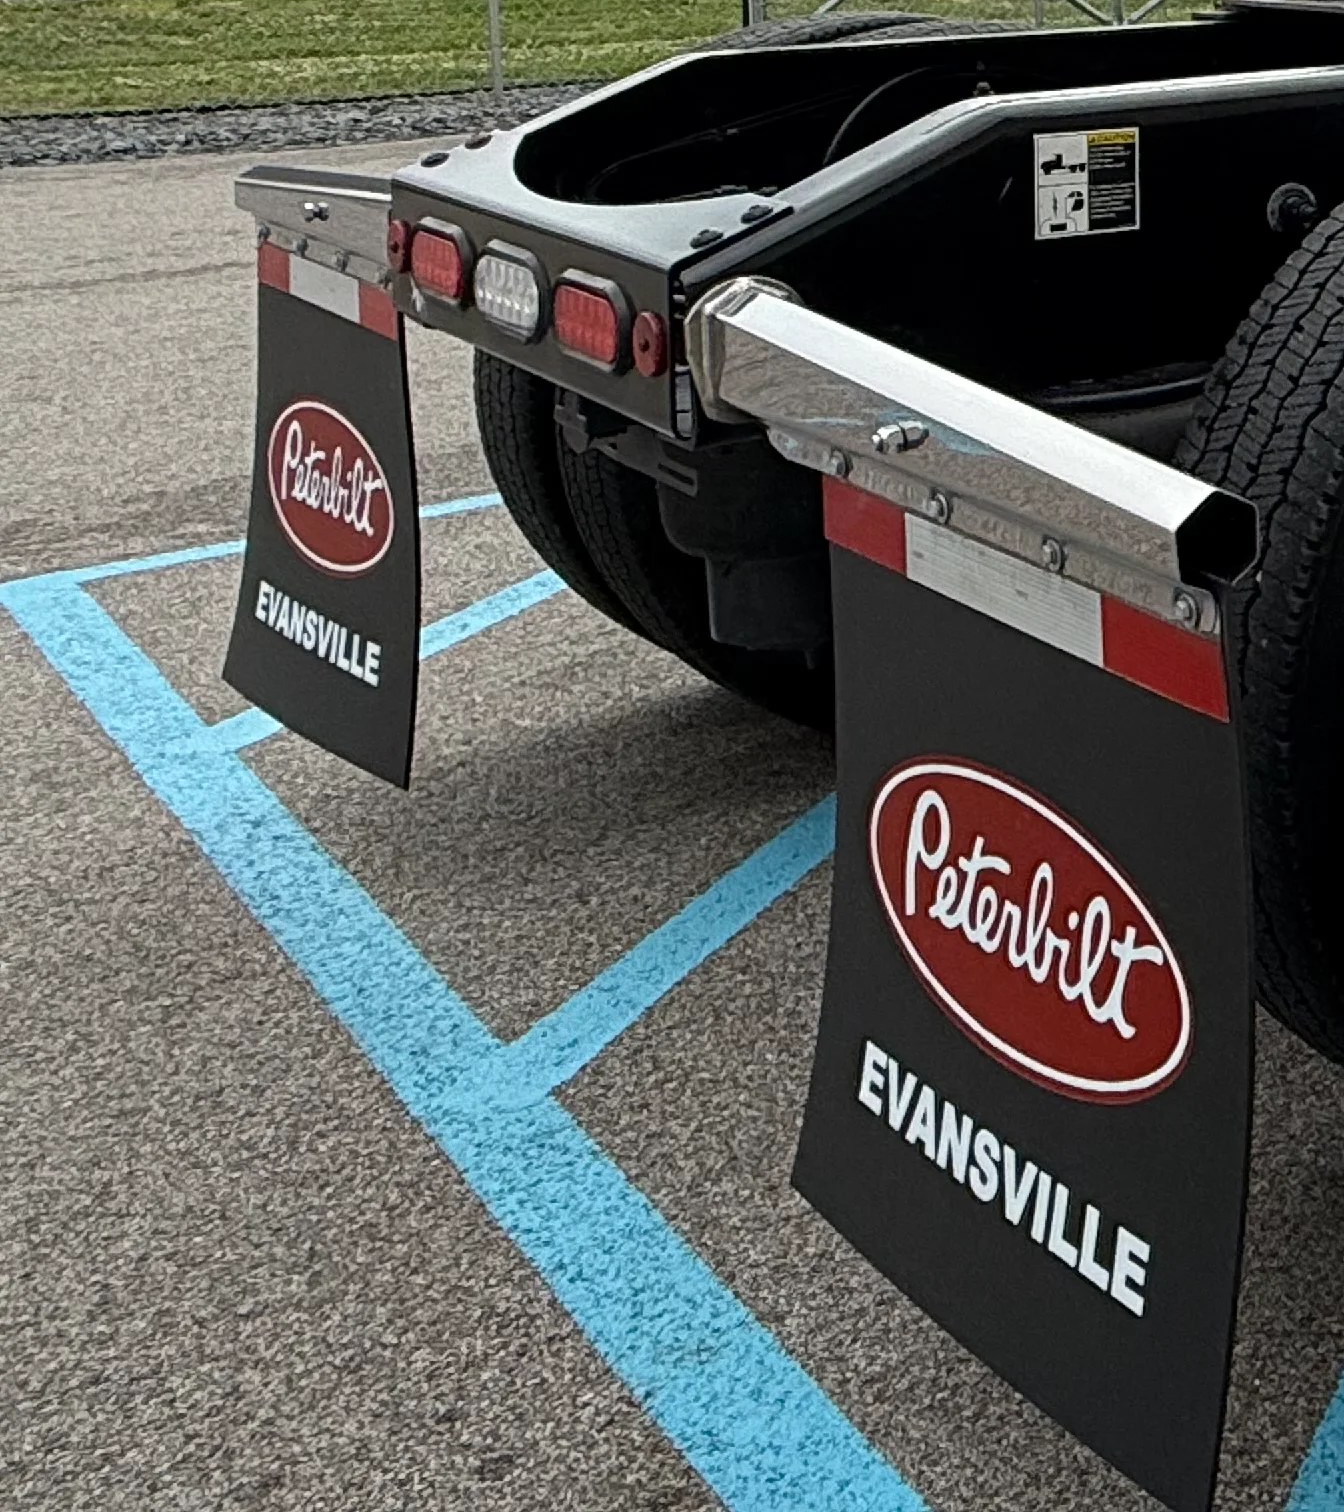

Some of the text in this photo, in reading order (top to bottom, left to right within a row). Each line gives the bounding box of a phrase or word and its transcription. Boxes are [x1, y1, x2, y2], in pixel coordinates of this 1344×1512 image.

[280, 420, 383, 537] Peterbilt
[254, 580, 382, 687] EVANSVILLE
[905, 789, 1164, 1039] Peterbilt
[856, 1039, 1152, 1318] EVANSVILLE
